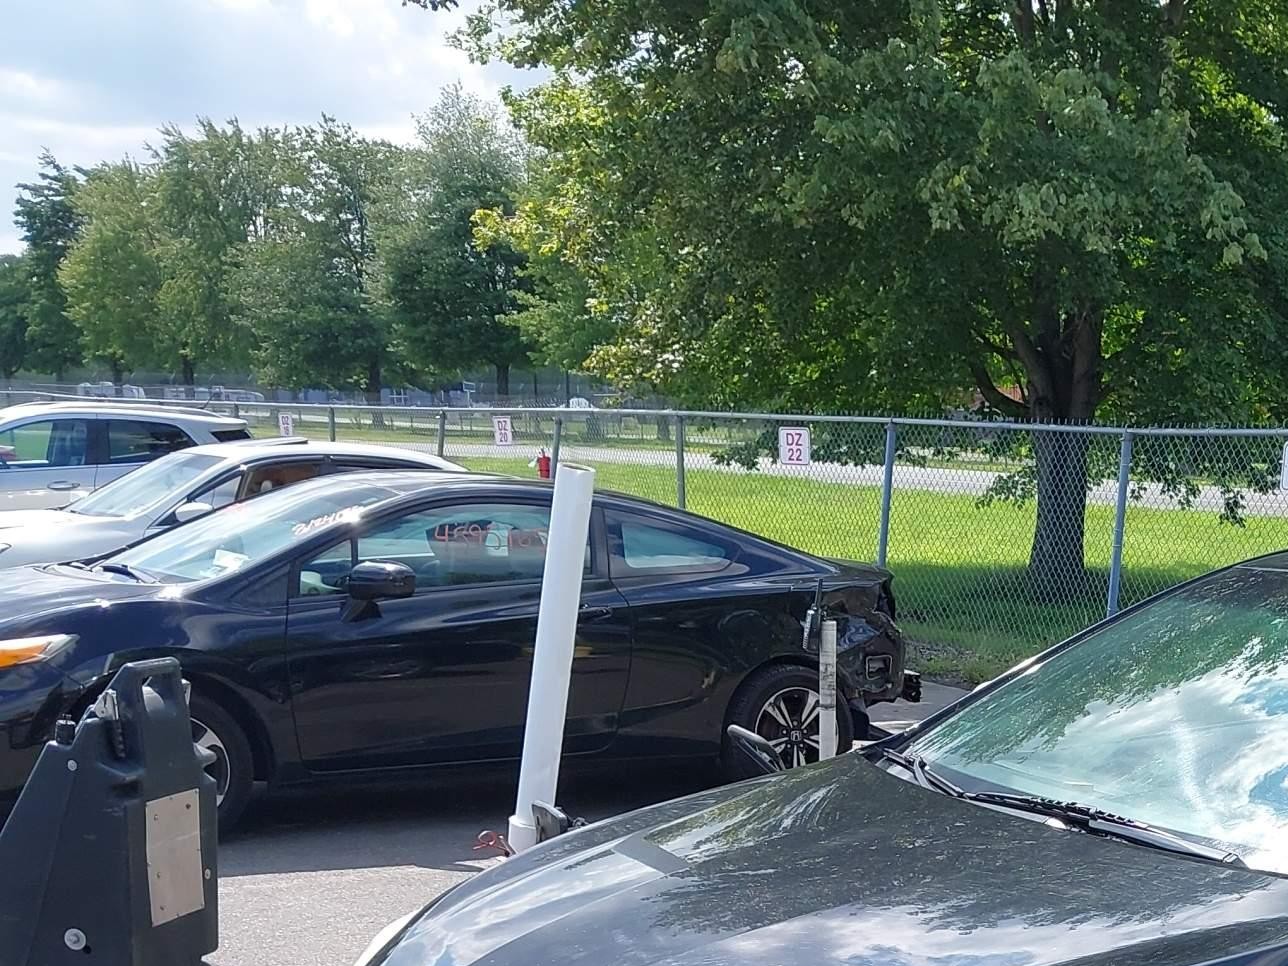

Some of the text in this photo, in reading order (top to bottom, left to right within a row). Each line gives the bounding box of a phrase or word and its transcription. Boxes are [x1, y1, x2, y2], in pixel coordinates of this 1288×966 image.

[497, 420, 508, 431] DZ
[499, 431, 508, 442] 20
[785, 432, 803, 446] DZ
[787, 448, 803, 461] 22
